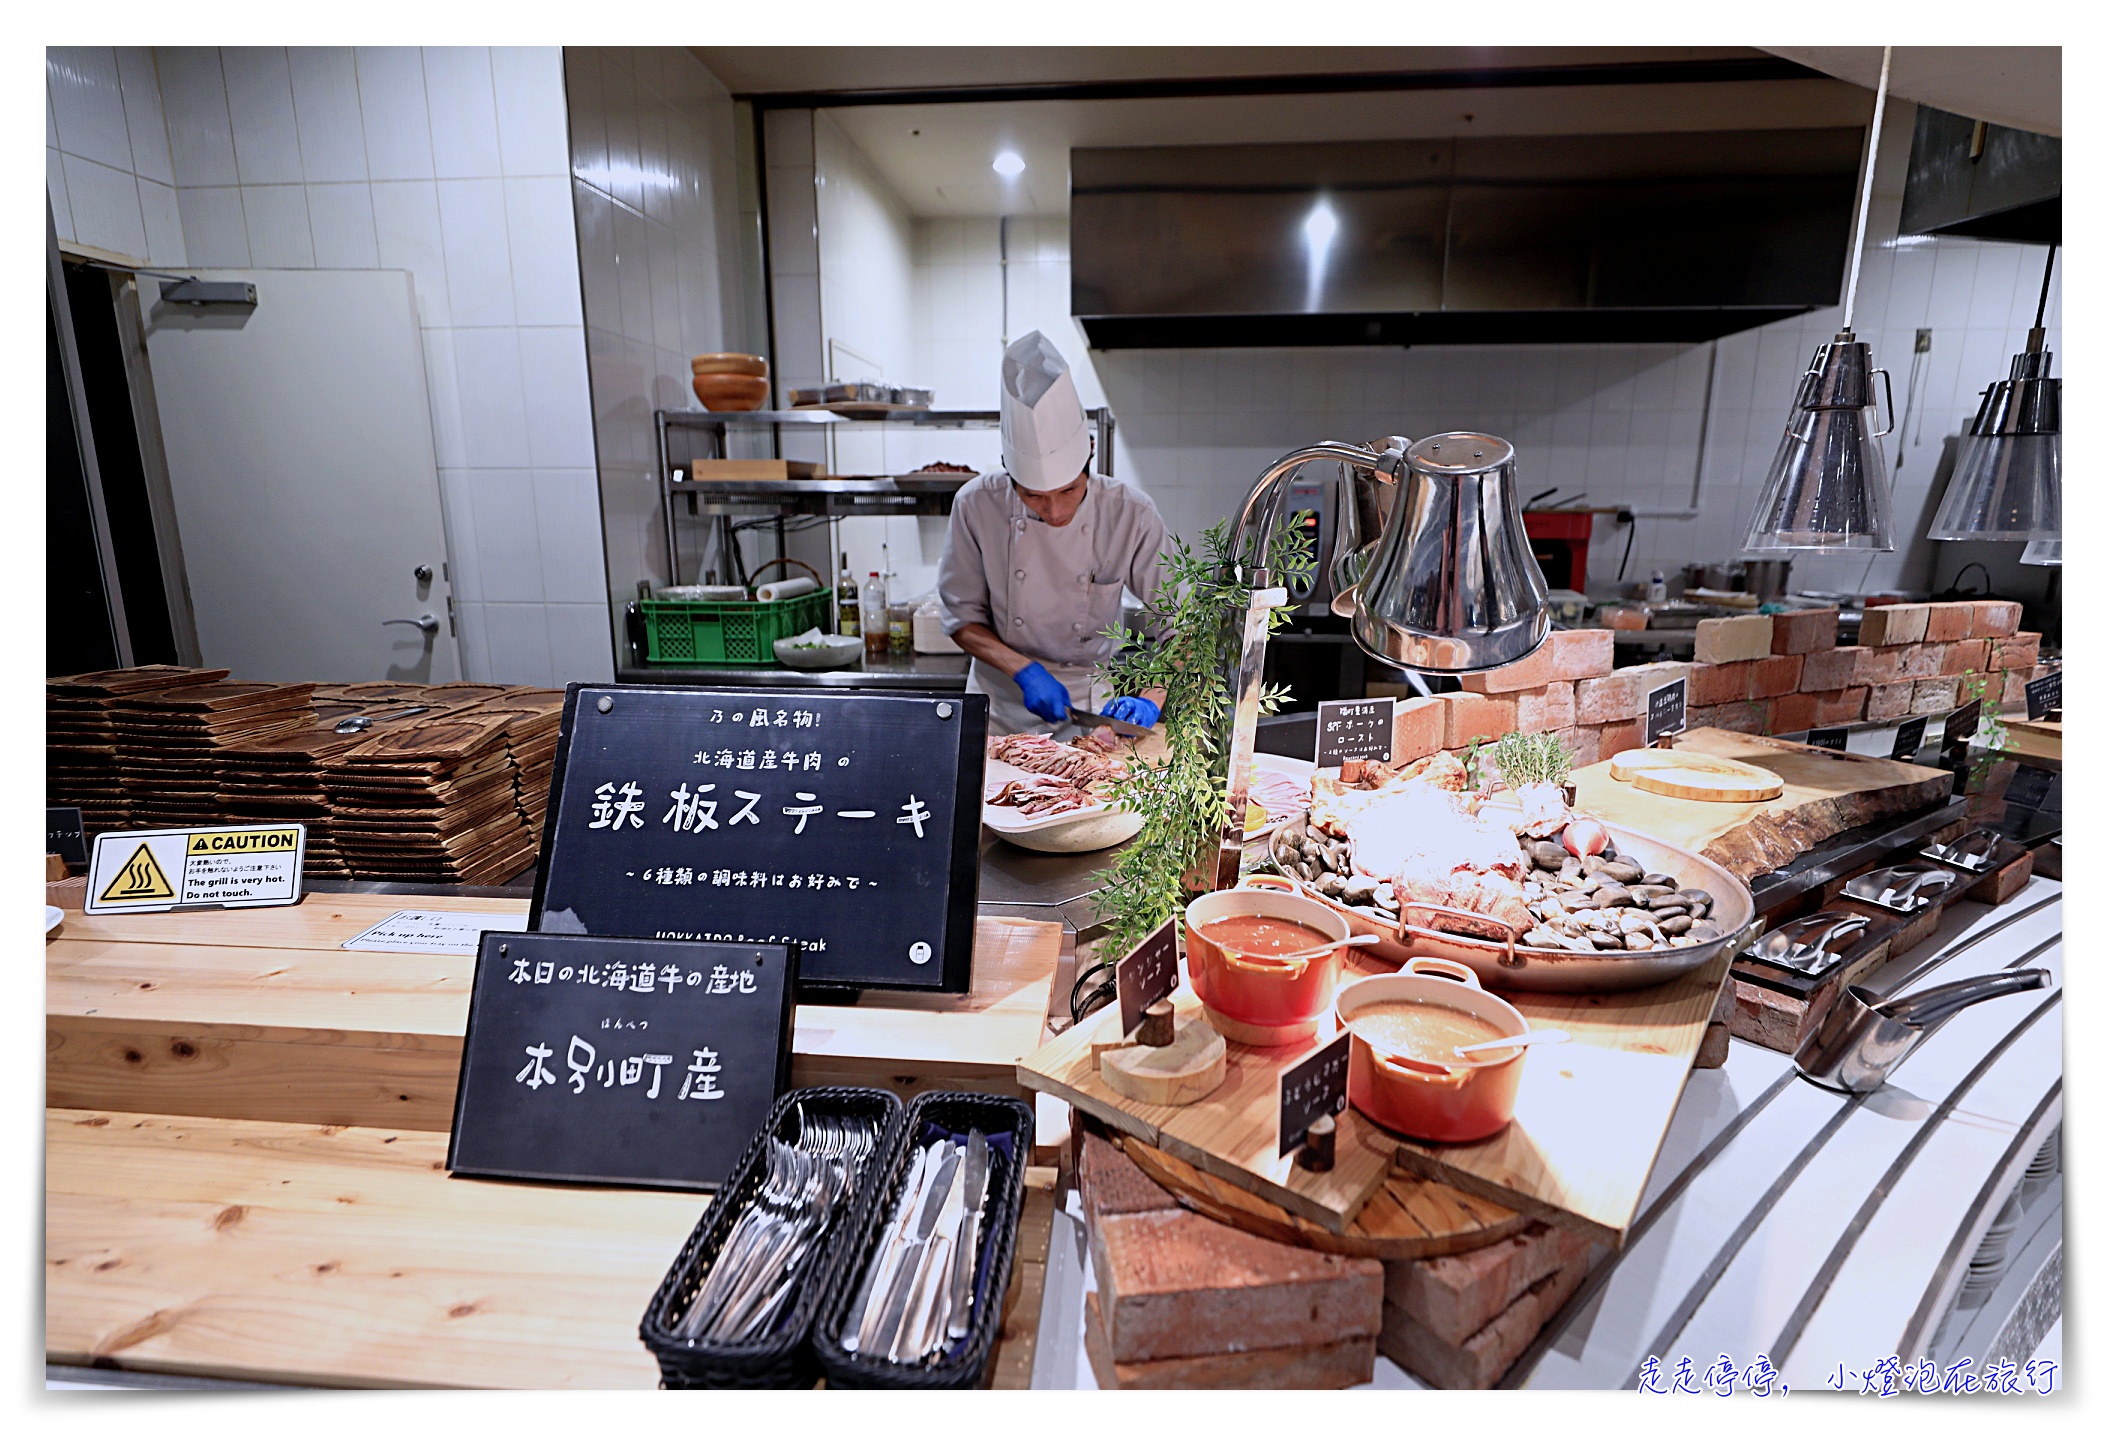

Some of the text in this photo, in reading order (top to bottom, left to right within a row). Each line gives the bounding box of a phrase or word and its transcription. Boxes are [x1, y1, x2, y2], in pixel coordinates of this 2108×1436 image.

[1338, 732, 1373, 744] ロースト
[692, 749, 850, 771] 北海道産牛肉 の
[588, 780, 932, 838] 鉄板ステーキ
[211, 834, 294, 850] CAUTION
[188, 875, 285, 888] The grill is very hot.
[186, 888, 253, 900] Do not touch.
[416, 932, 443, 940] here
[508, 957, 758, 995] 本日の北海道牛の産地
[515, 1034, 726, 1101] 本別町産
